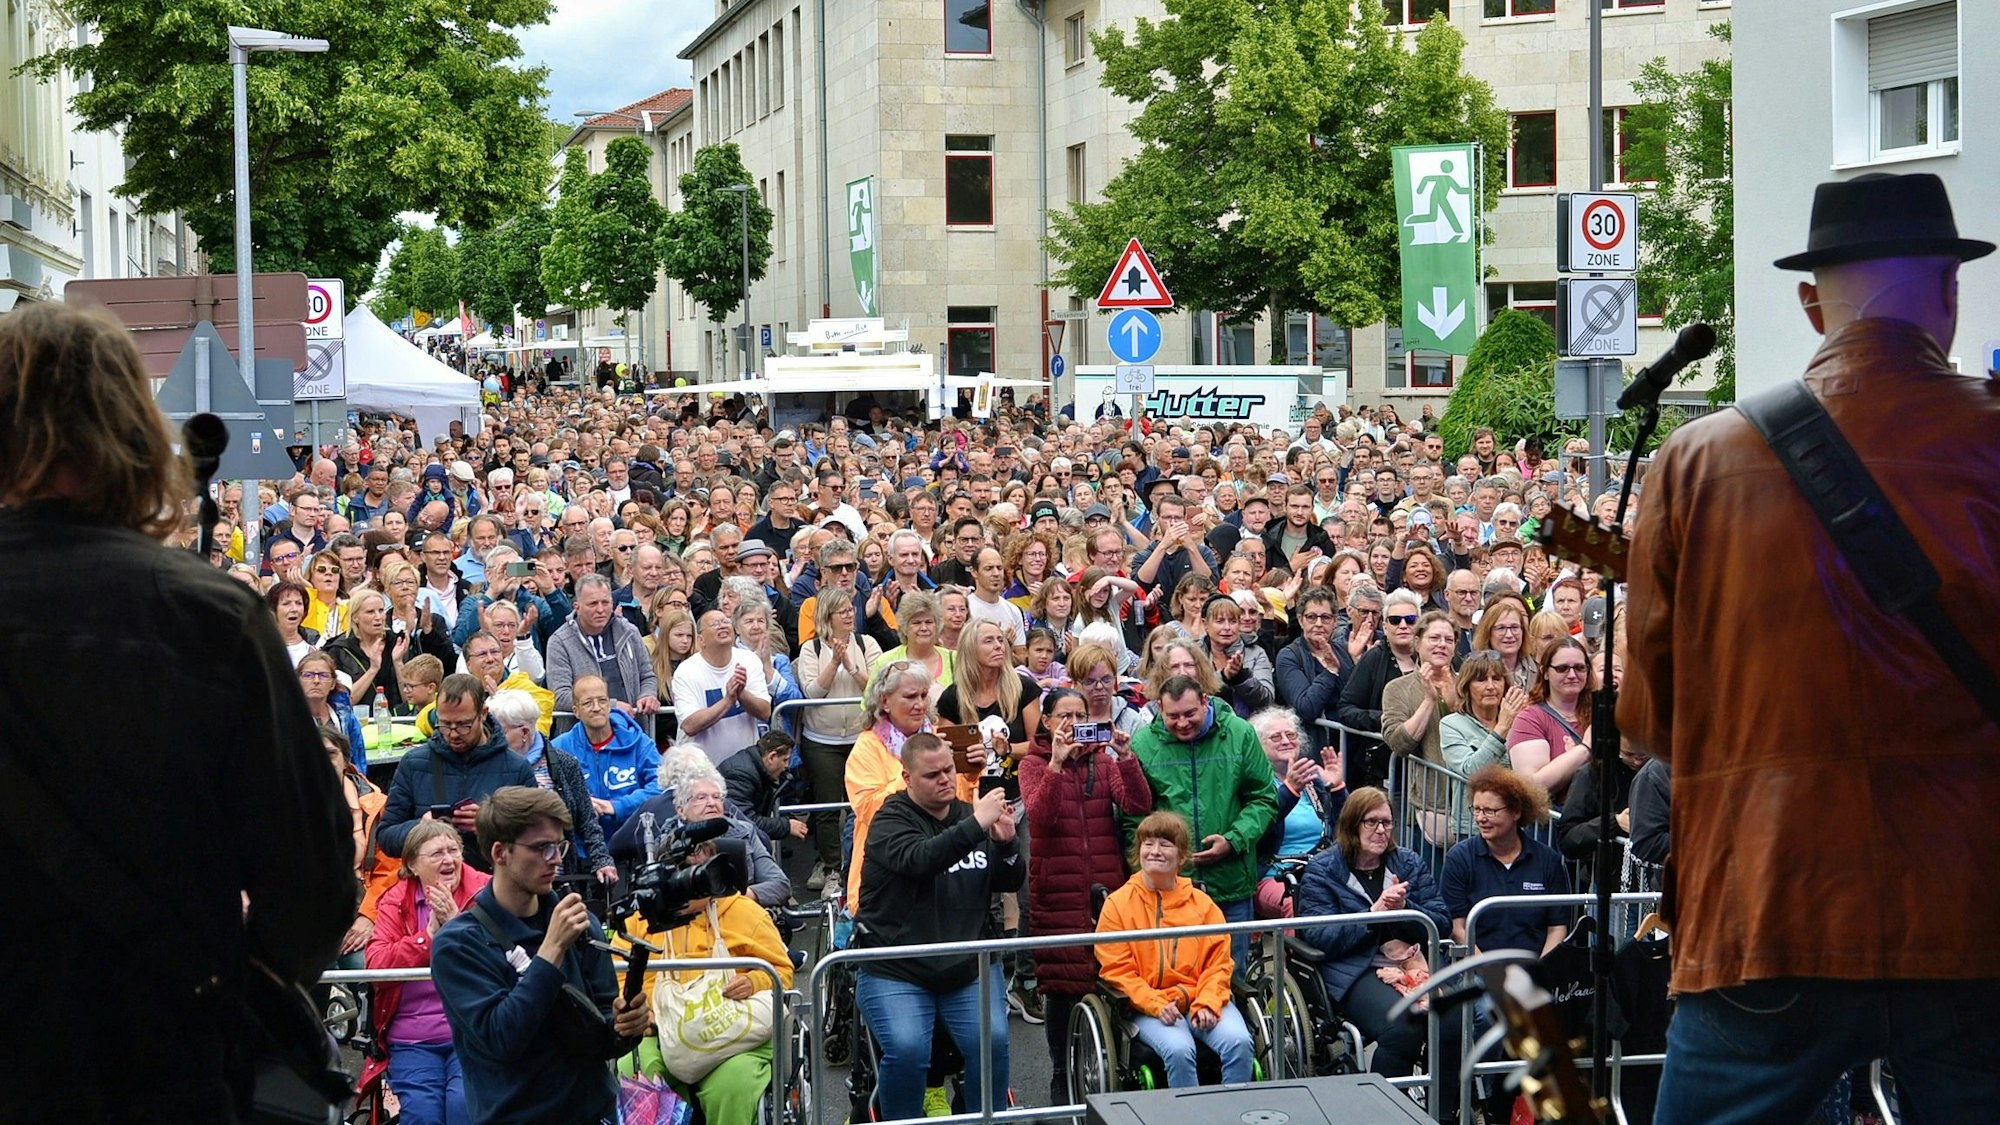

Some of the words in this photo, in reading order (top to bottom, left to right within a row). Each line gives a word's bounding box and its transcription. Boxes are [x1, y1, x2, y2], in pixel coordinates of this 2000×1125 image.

[1591, 213, 1616, 236] 30
[1587, 253, 1620, 266] ZONE
[306, 326, 329, 337] ONE
[1586, 338, 1620, 351] ZONE
[300, 384, 330, 395] ZONE
[1146, 386, 1266, 419] Hutter
